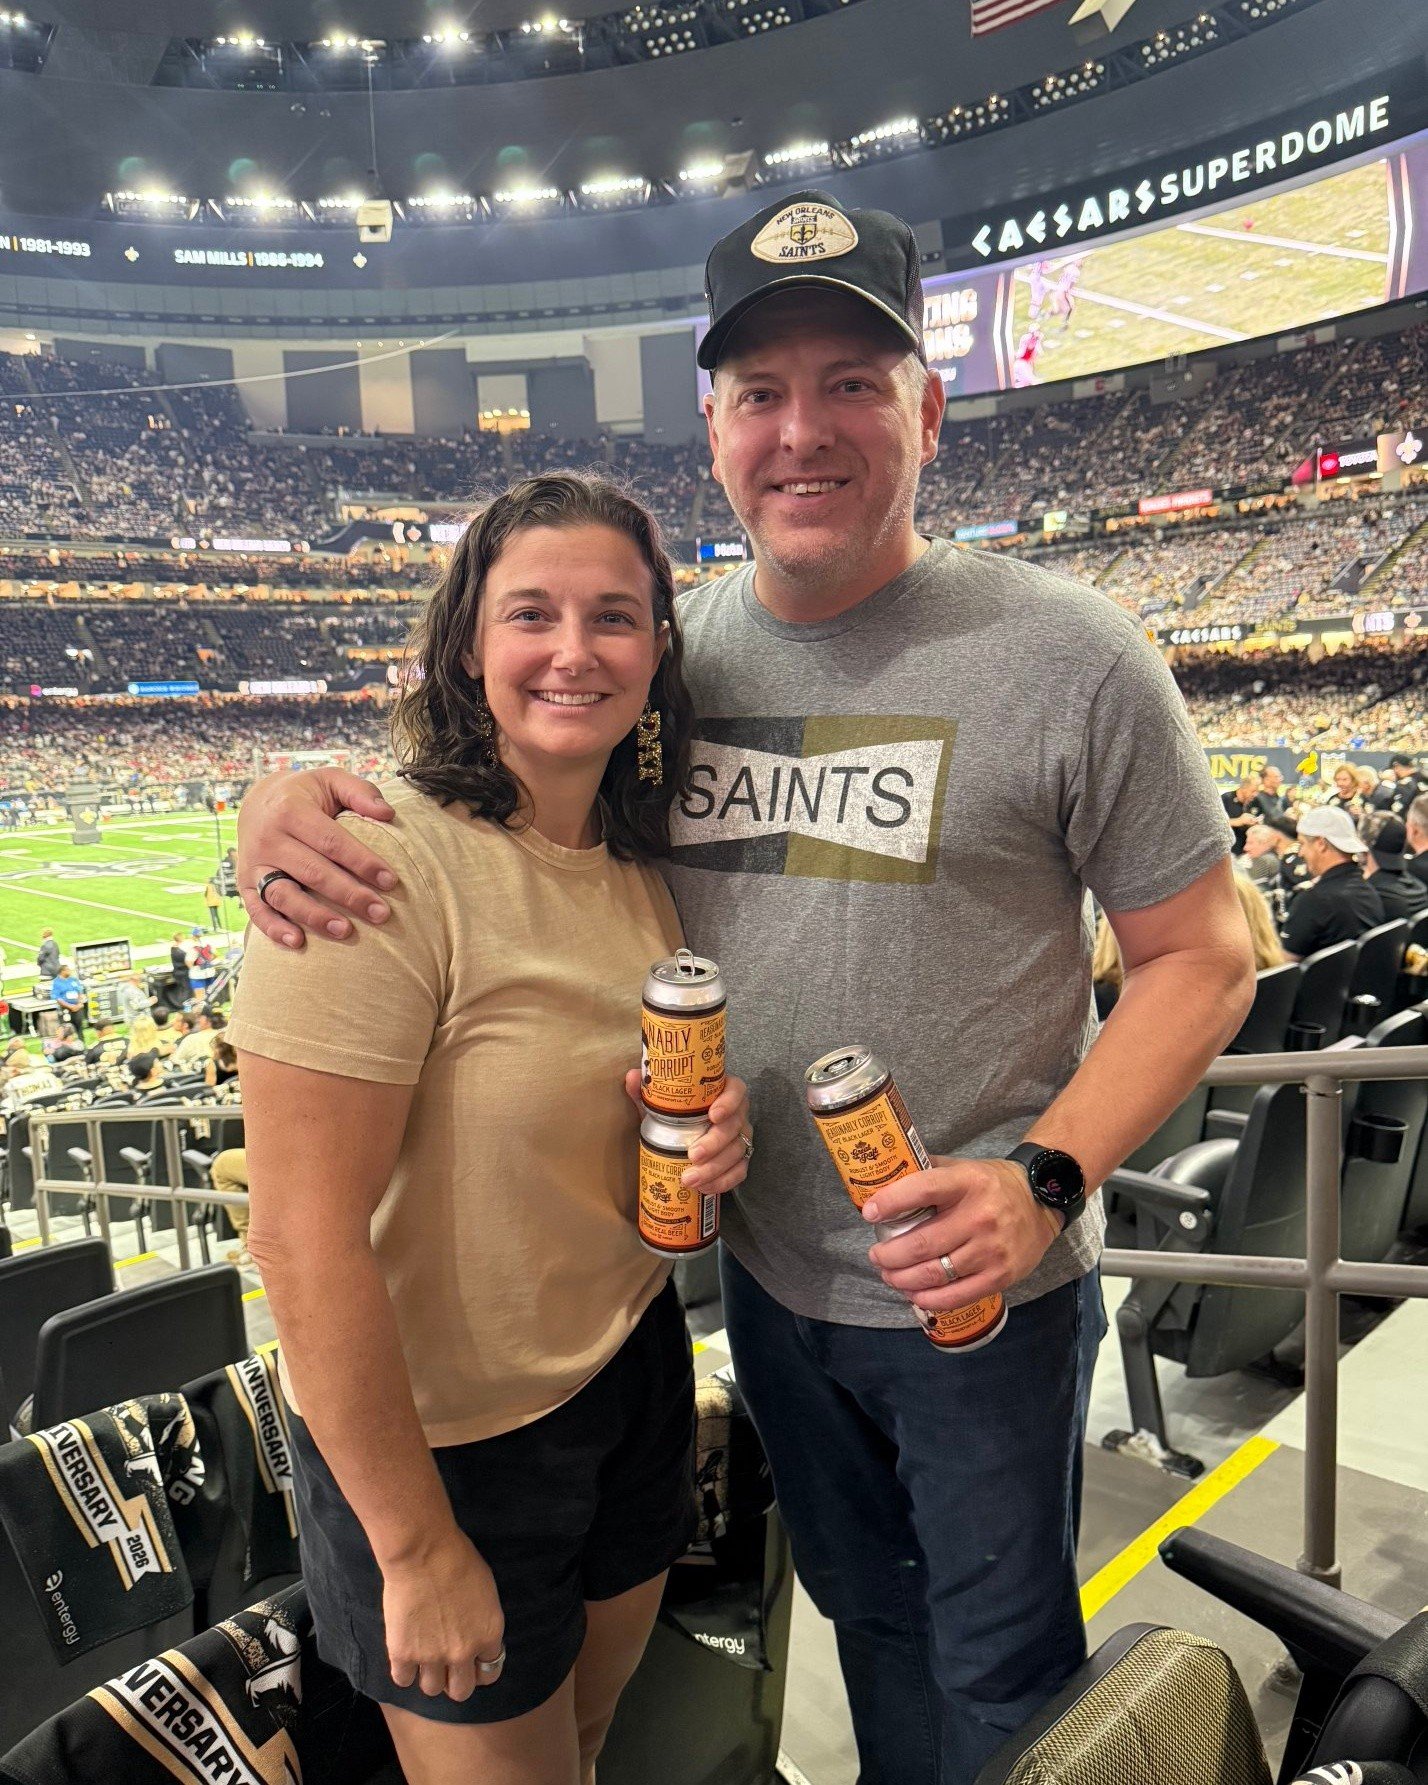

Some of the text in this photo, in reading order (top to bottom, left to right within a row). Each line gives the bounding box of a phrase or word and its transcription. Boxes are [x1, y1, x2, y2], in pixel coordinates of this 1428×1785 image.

[971, 95, 1390, 257] CAESARS SUPERDOME
[777, 210, 793, 225] NEW
[795, 207, 835, 219] ORLEANS
[20, 238, 91, 257] 1981-1993
[779, 242, 826, 258] SAINTS
[174, 250, 206, 264] SAM
[207, 251, 247, 266] MILLS
[1170, 625, 1242, 645] CAESARS
[679, 764, 915, 829] SAINTS
[650, 1055, 695, 1081] CORRUPT
[652, 1082, 692, 1095] BLACK LAGER
[858, 1111, 888, 1130] CORRUPT
[842, 1129, 874, 1145] BLACK LAGER
[875, 1155, 898, 1168] SMOOTH
[859, 1166, 891, 1179] LIGHT BODY
[662, 1205, 685, 1213] SMOOTH
[654, 1227, 667, 1235] REAL
[940, 1305, 982, 1327] BLACK LAGER
[46, 1425, 118, 1529] IVERSARY
[126, 1534, 150, 1569] 2026
[52, 1592, 81, 1645] entergy
[692, 1633, 745, 1655] ntergy
[118, 1663, 249, 1785] VERSARY
